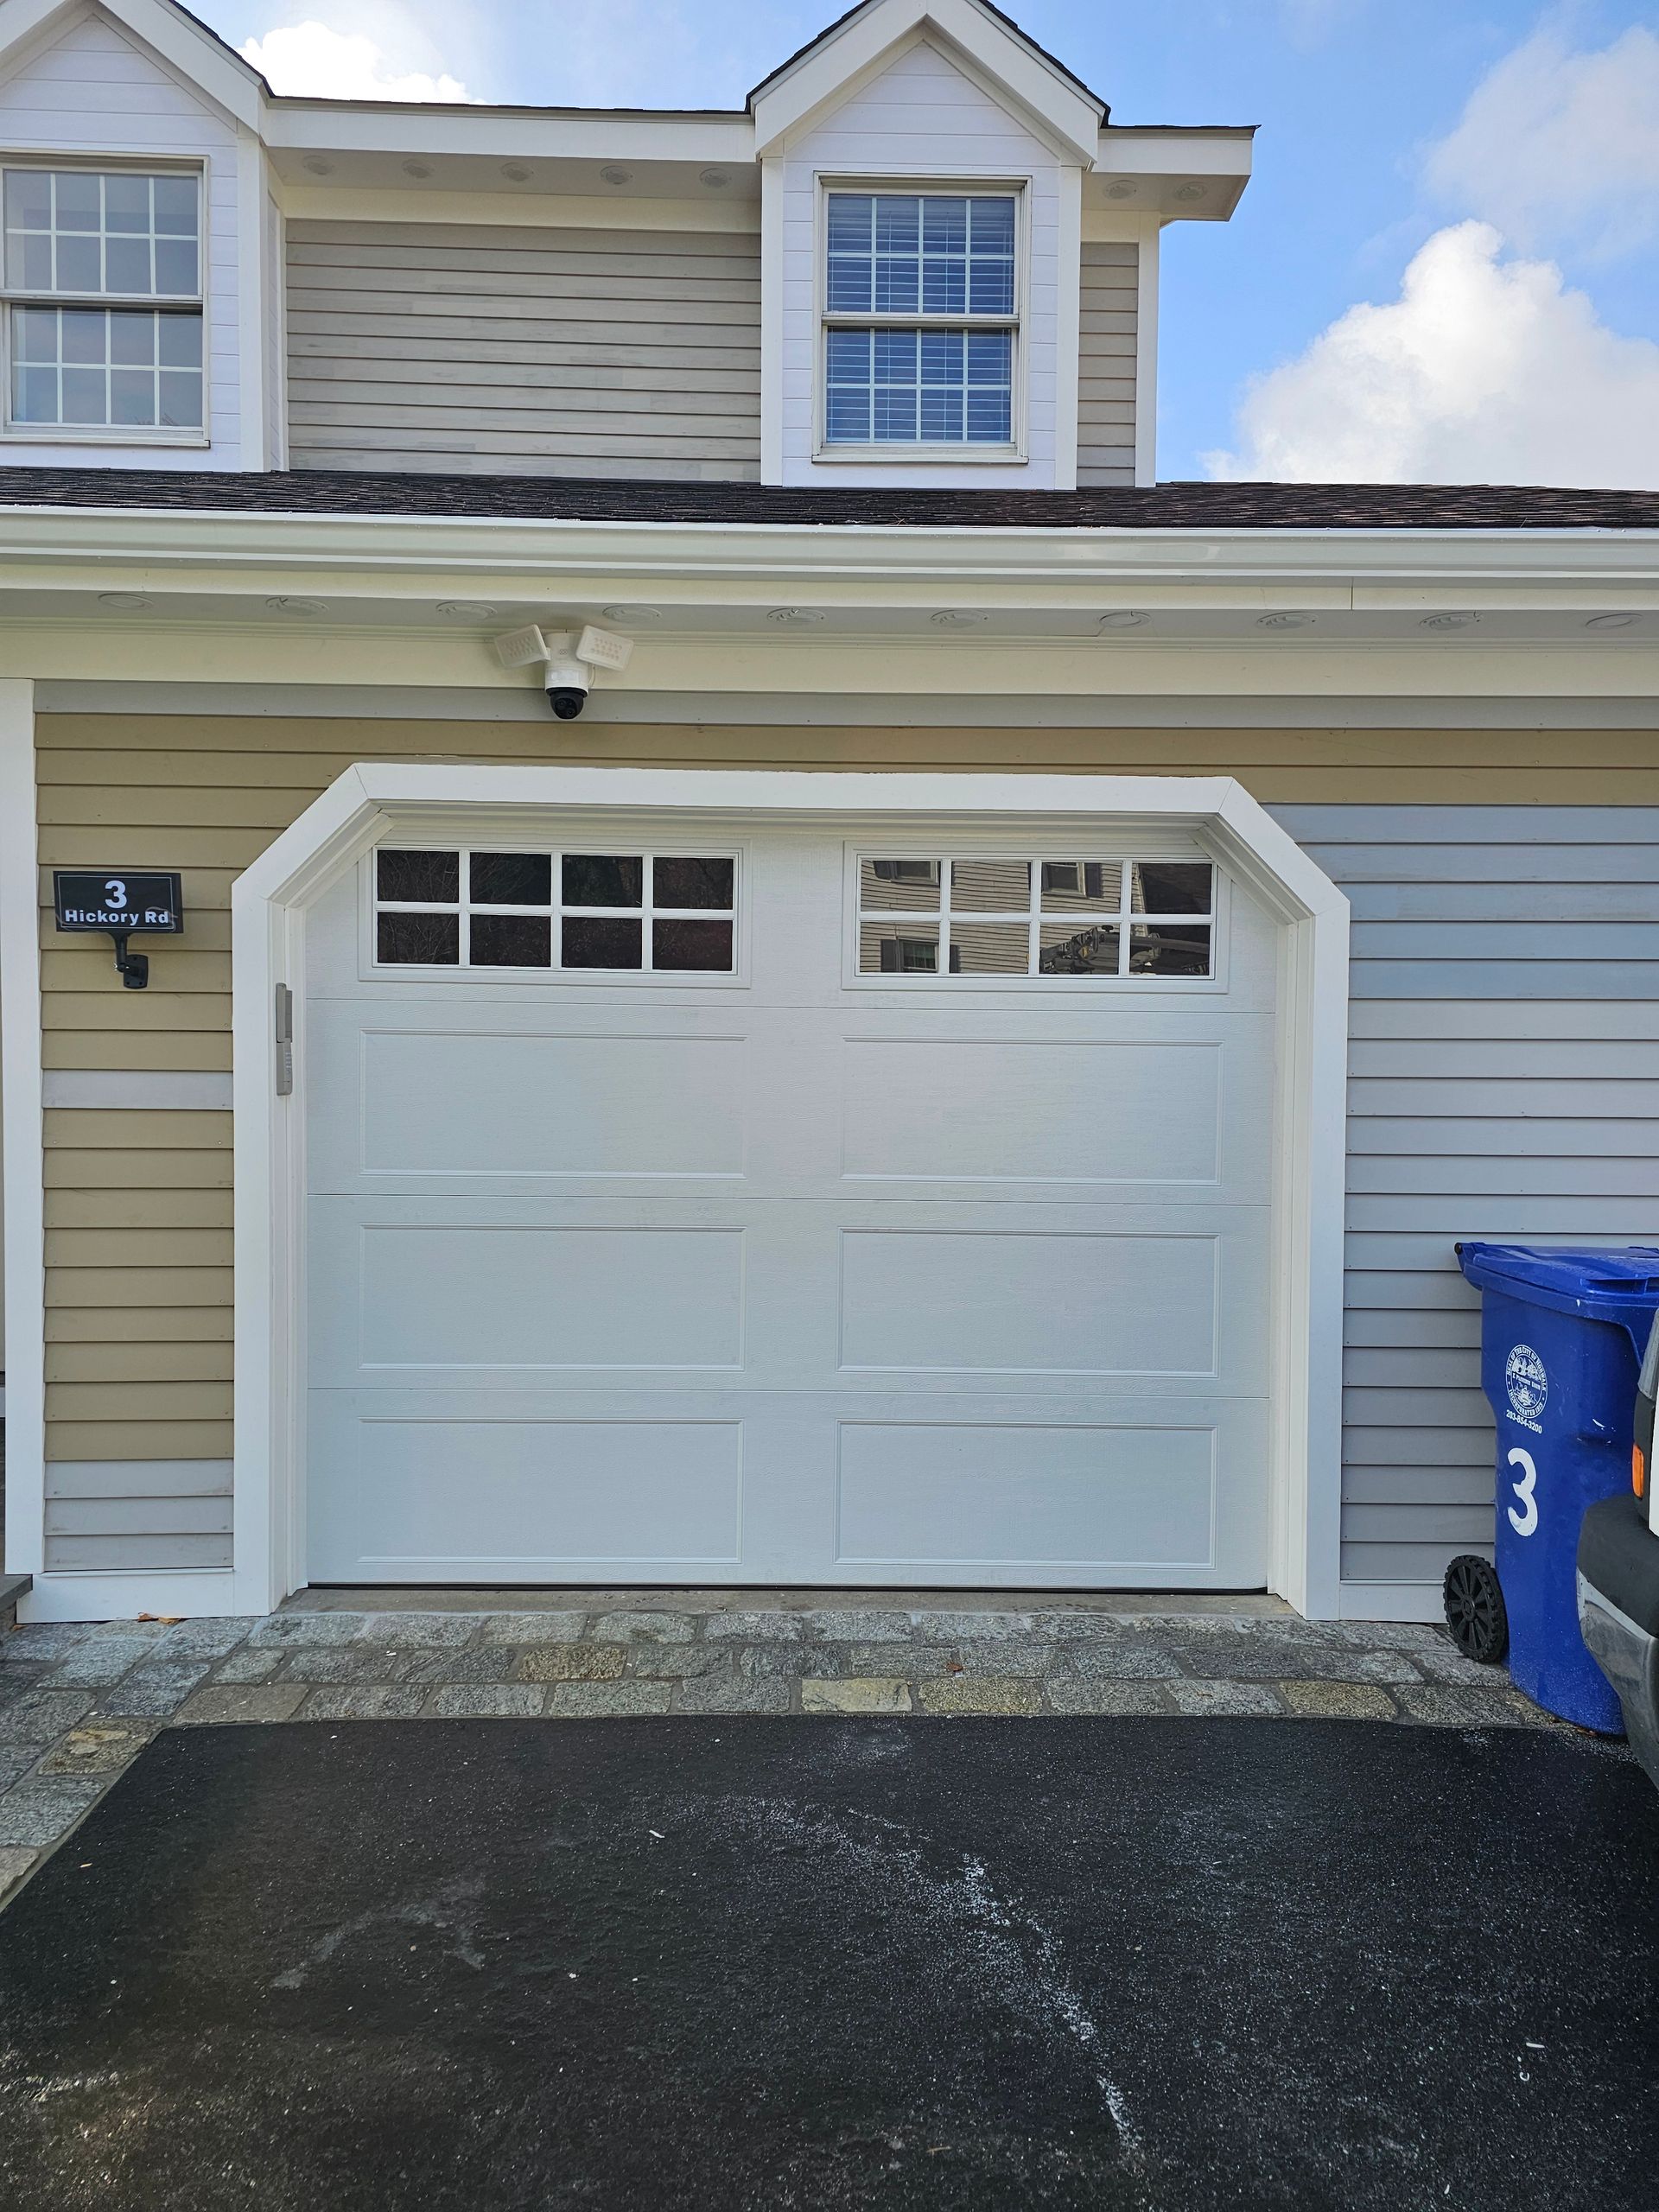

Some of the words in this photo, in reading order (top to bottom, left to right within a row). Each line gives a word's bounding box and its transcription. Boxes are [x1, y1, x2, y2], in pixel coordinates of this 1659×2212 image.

[105, 880, 127, 908] 3
[65, 910, 139, 926] Hickory
[144, 911, 168, 924] Rd
[1506, 1409, 1542, 1434] 203-854-3200
[1507, 1447, 1538, 1537] 3
